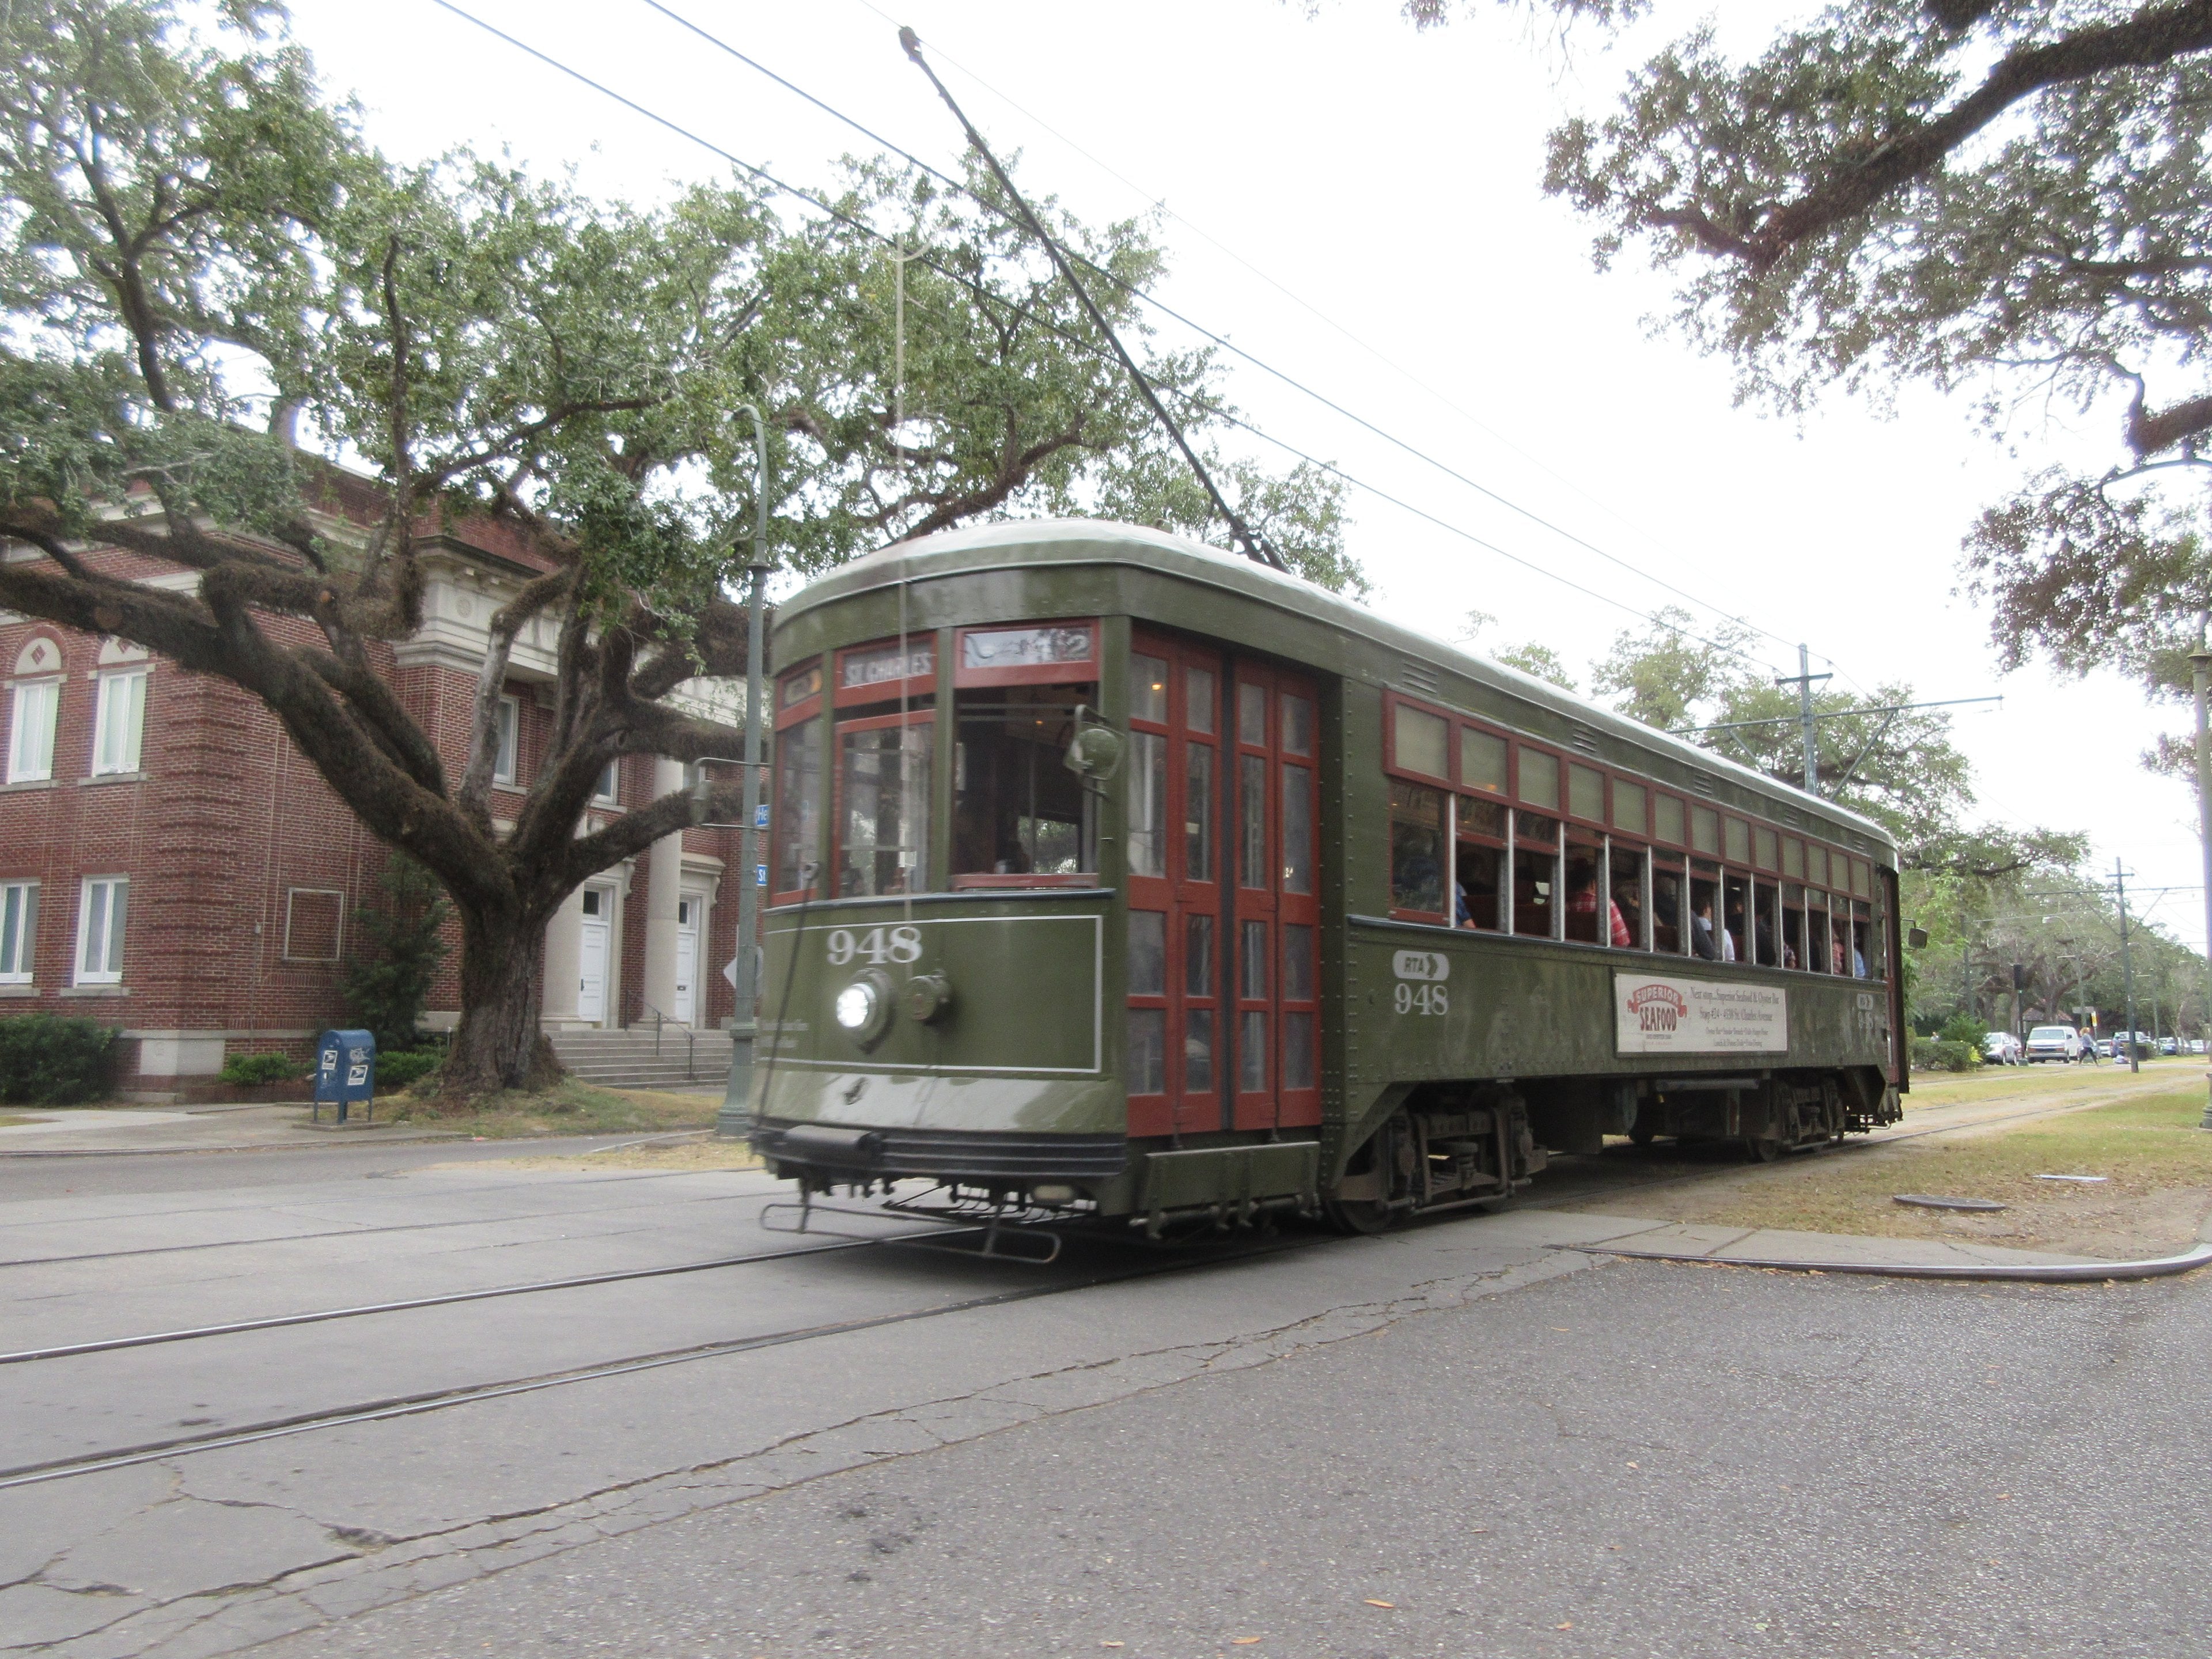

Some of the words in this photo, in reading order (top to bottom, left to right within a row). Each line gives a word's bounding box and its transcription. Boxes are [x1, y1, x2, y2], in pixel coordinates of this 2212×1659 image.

[757, 807, 768, 821] He
[758, 869, 766, 882] St
[827, 927, 922, 965] 948
[1403, 957, 1425, 974] RTA
[1395, 983, 1449, 1016] 948
[1635, 986, 1679, 1005] SUPERIOR
[1639, 1006, 1677, 1031] SEAFOOD
